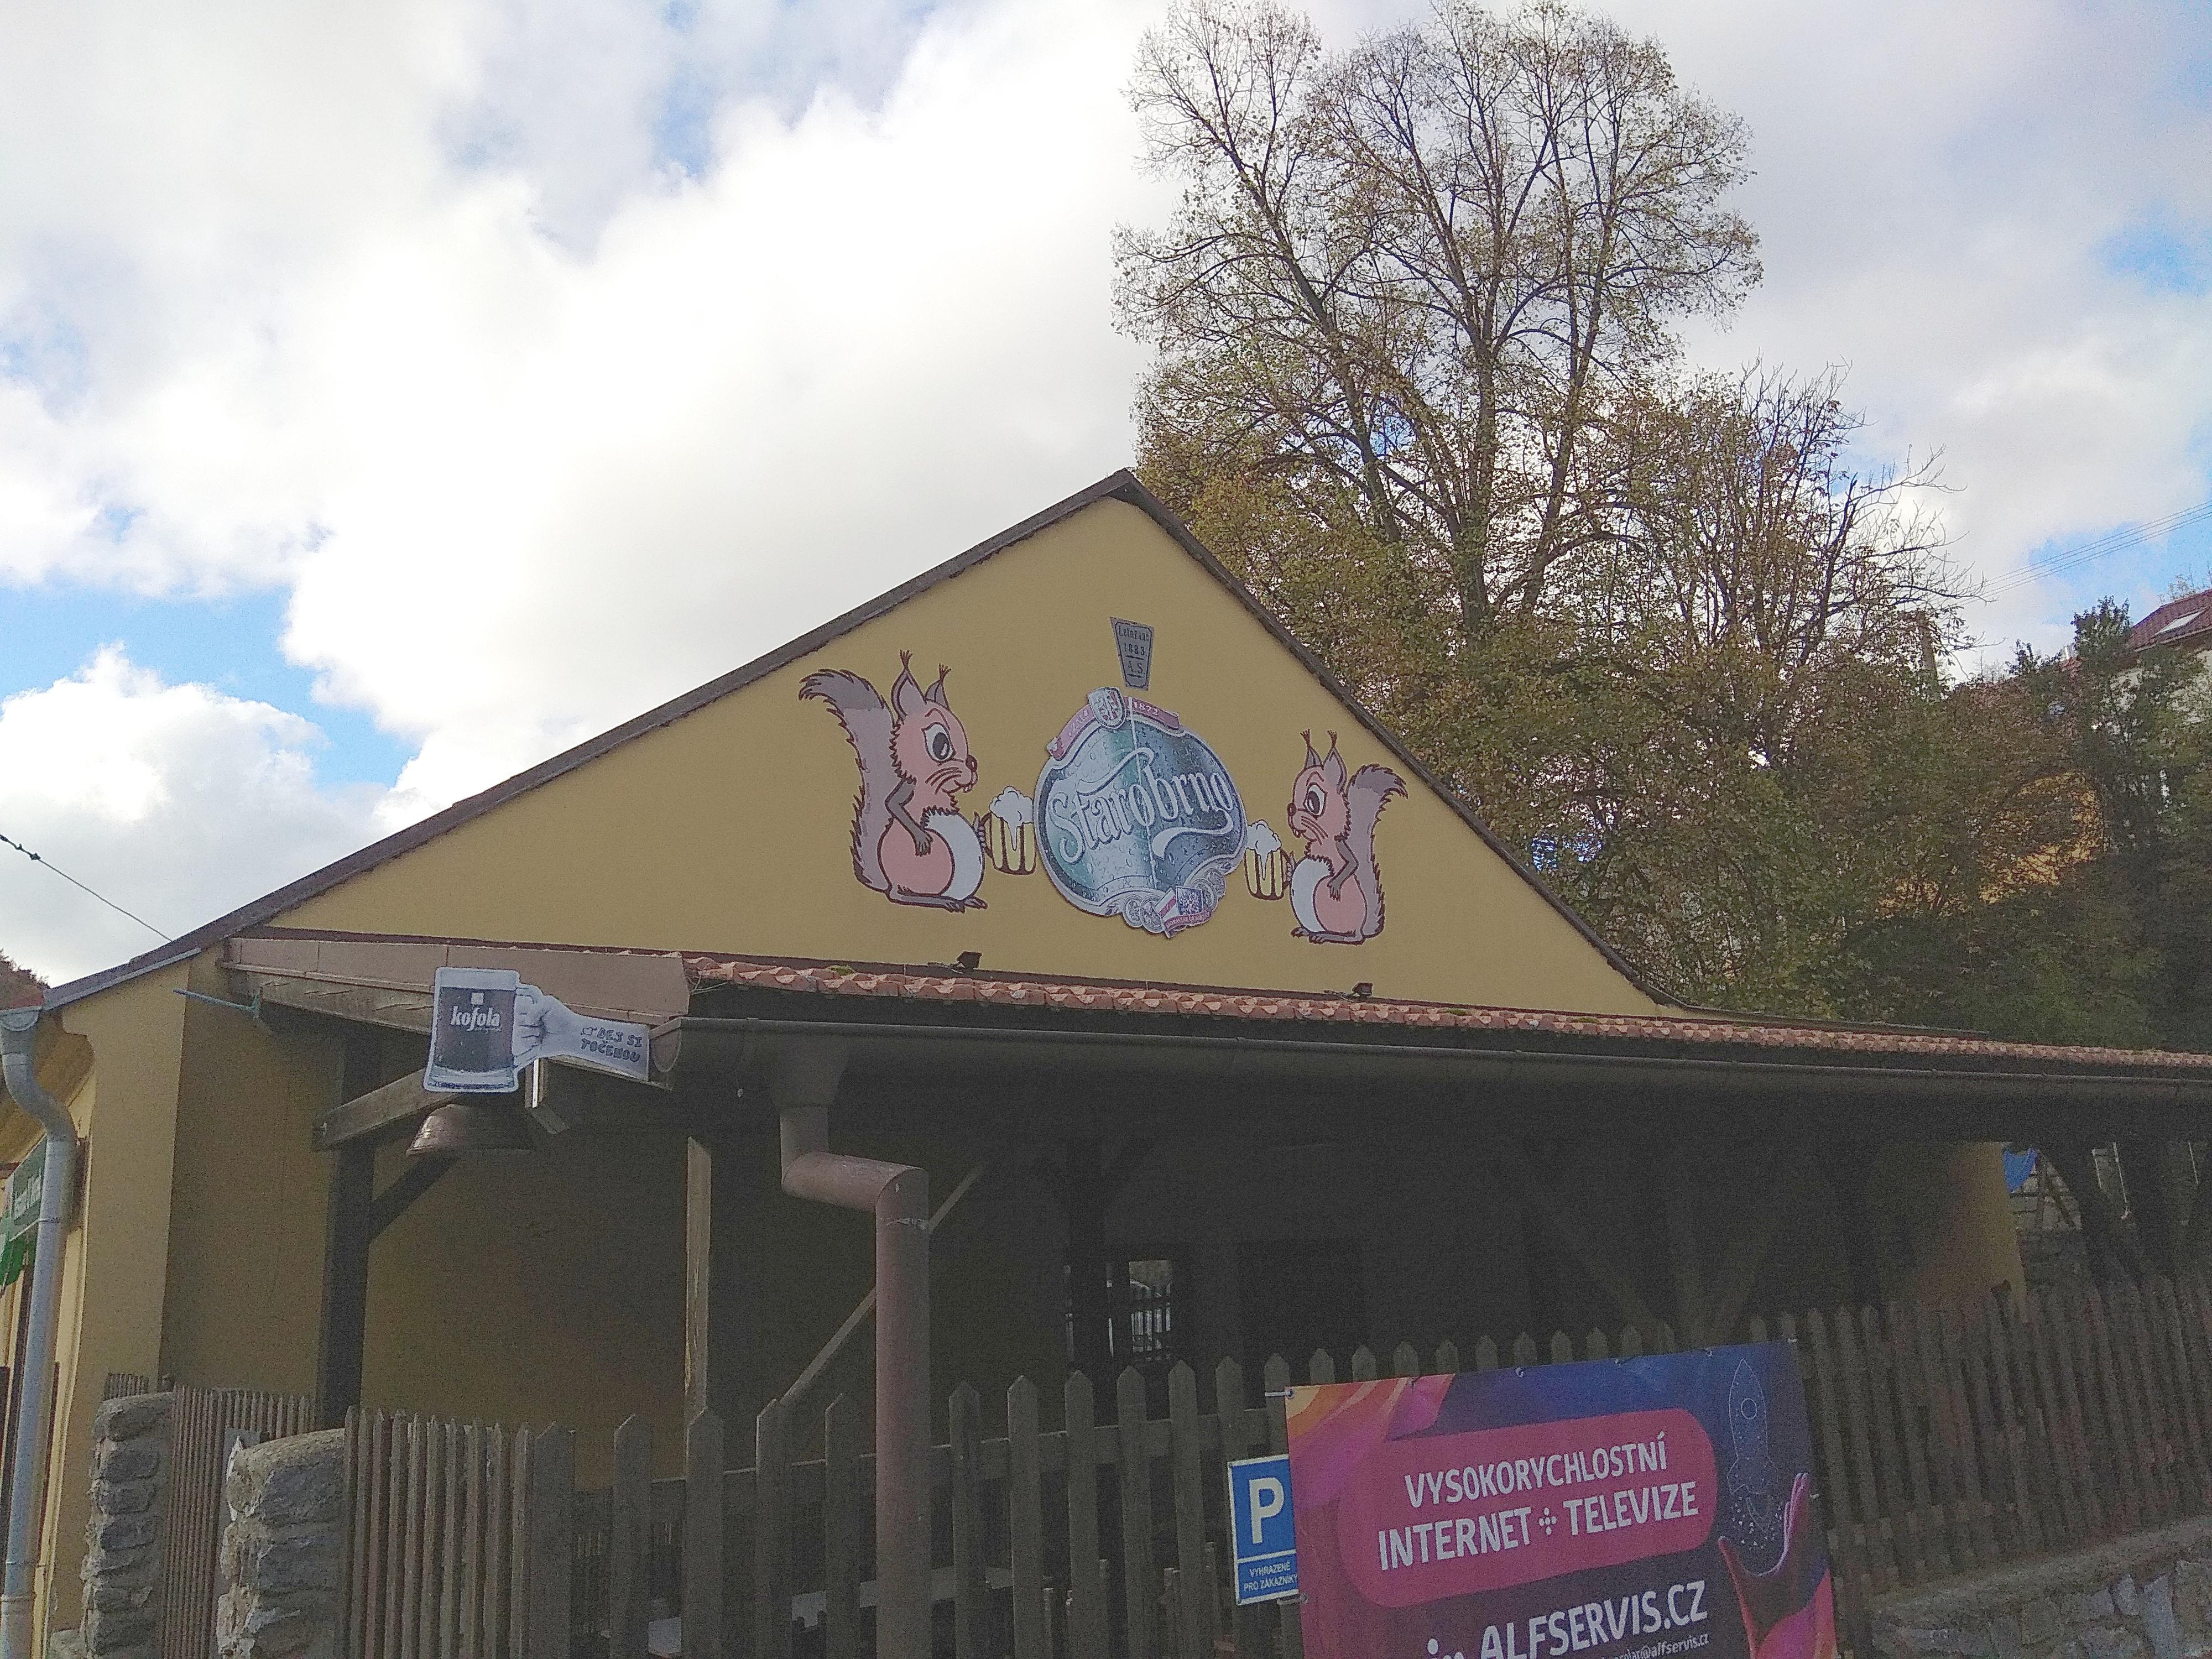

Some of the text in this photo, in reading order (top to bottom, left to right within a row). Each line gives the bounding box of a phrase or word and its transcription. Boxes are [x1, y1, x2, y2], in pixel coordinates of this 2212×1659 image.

[1133, 701, 1160, 717] 1872
[1048, 748, 1235, 864] Starobrno
[450, 1005, 501, 1032] kofola
[581, 1038, 641, 1062] TOČENOU
[597, 1027, 643, 1048] DEJ SI
[1405, 1431, 1667, 1508] VYSOKORYCHLOSTNÍ
[1249, 1477, 1285, 1544] P
[1378, 1481, 1699, 1571] INTERNET TELEVIZE
[1249, 1560, 1291, 1578] VYHRAZENÉ
[1244, 1581, 1259, 1592] PRO
[1480, 1580, 1708, 1659] ALFSERVIS.CZ
